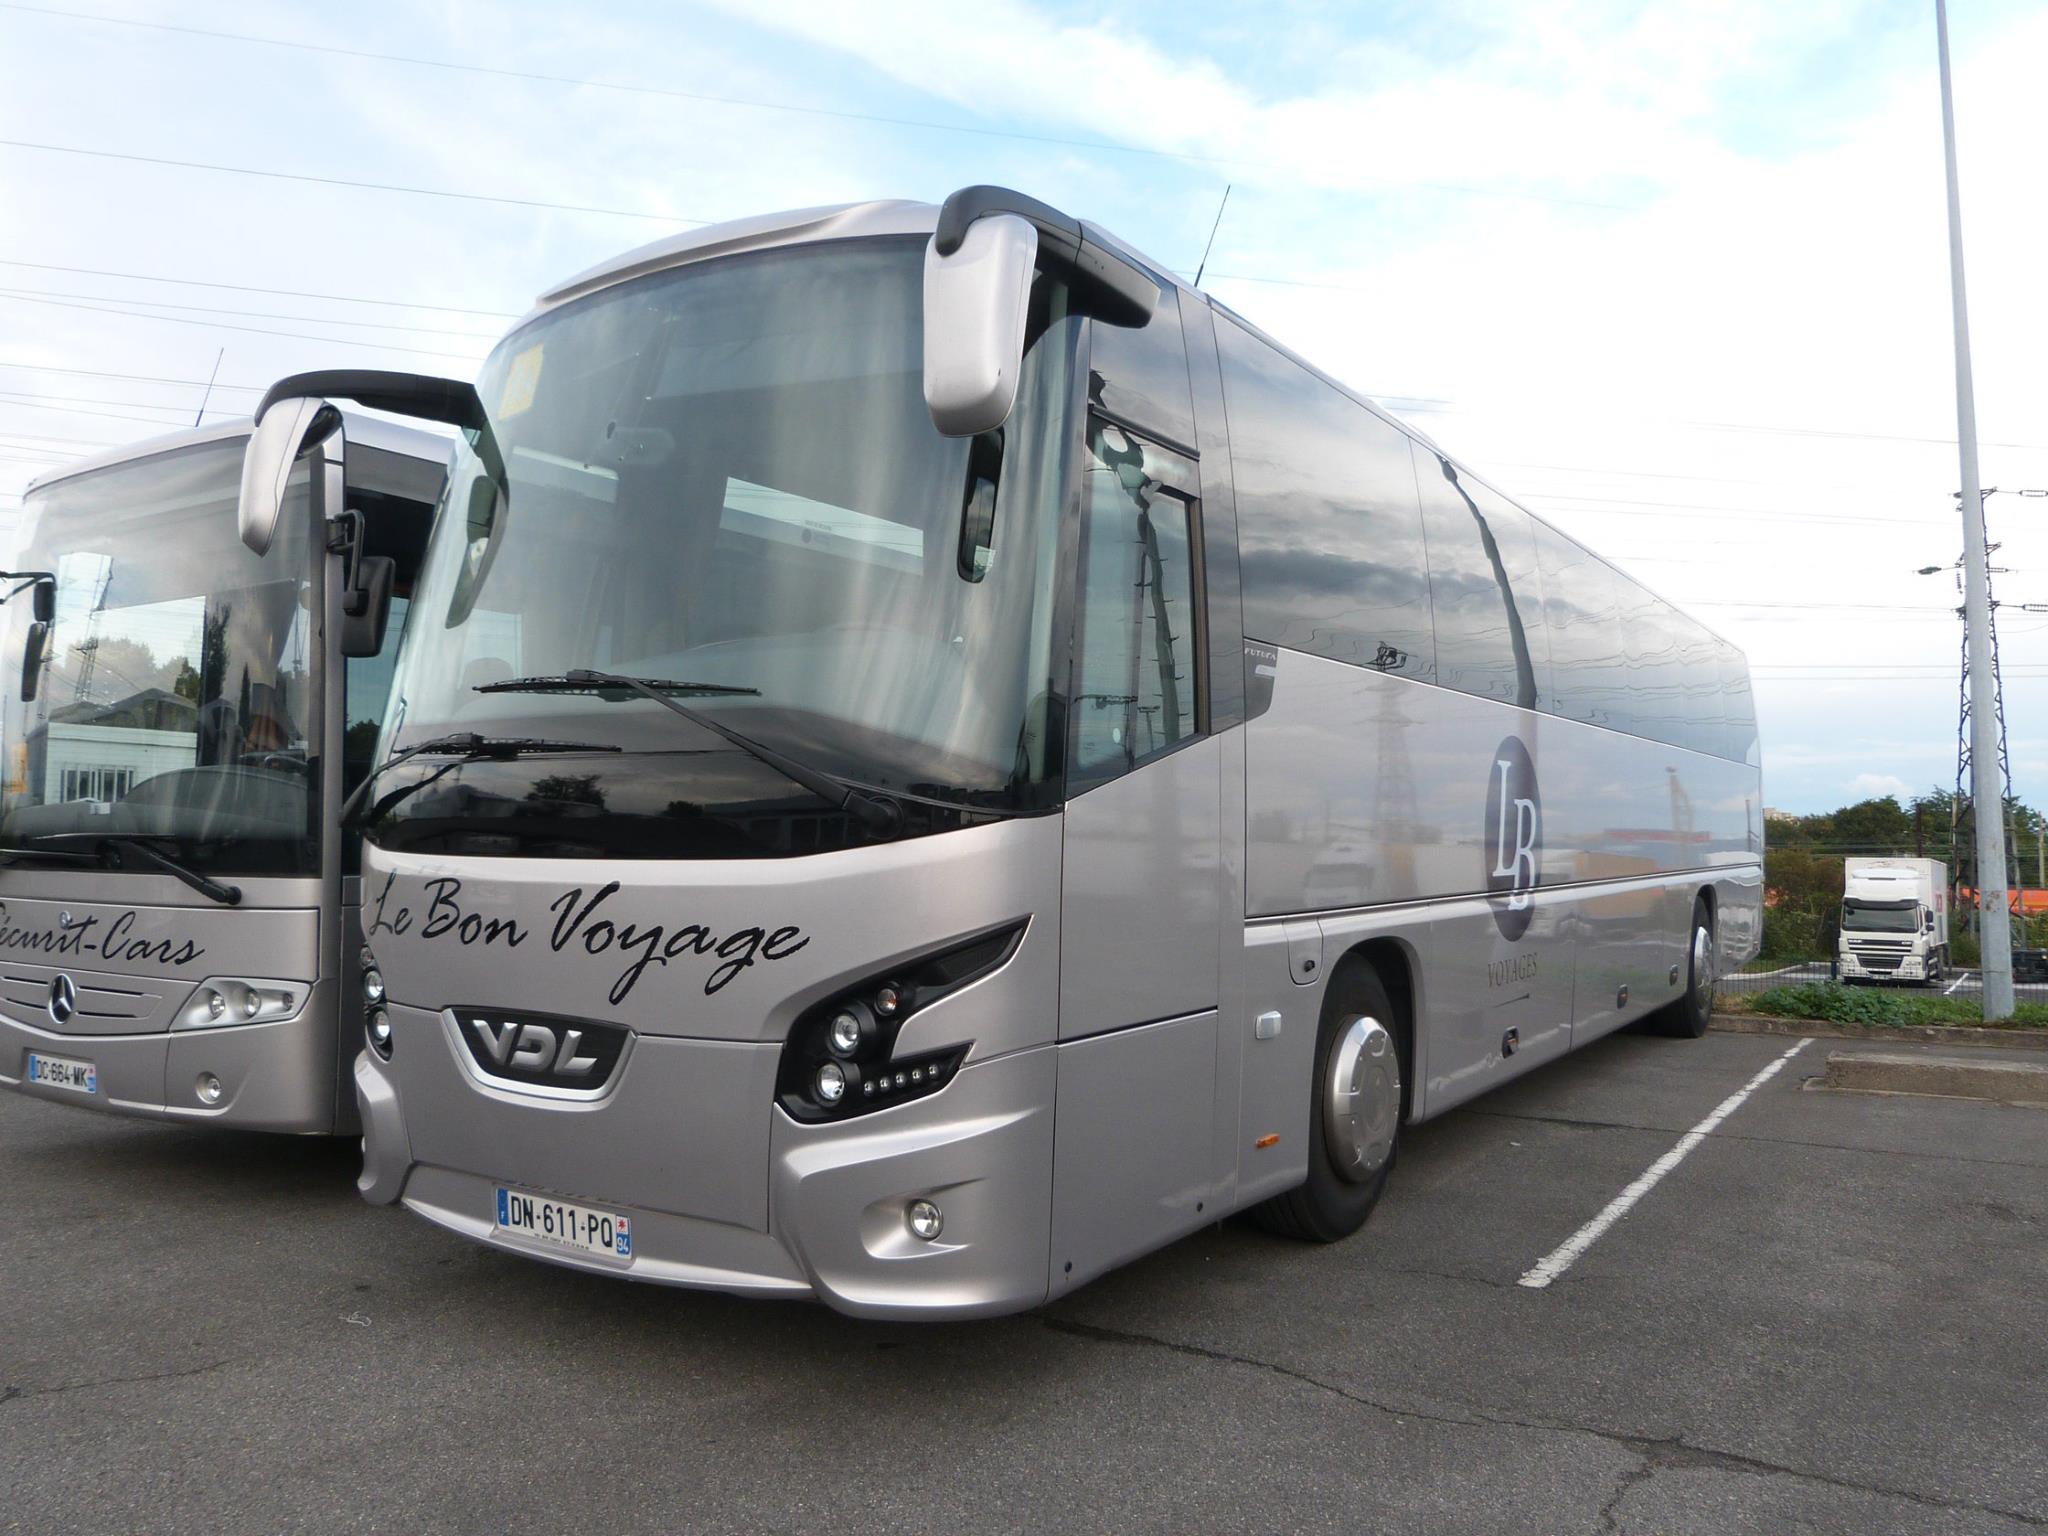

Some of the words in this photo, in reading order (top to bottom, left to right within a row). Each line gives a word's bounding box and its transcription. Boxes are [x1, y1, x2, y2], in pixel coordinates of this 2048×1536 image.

[0, 901, 205, 965] écurit-Cars
[369, 868, 413, 936] Le
[422, 877, 528, 947] Bon
[550, 880, 810, 1006] Voyage
[1488, 951, 1537, 989] VOYAGES
[472, 1019, 598, 1076] VDL
[510, 1195, 613, 1248] DN-611-PQ
[616, 1236, 629, 1252] 94
